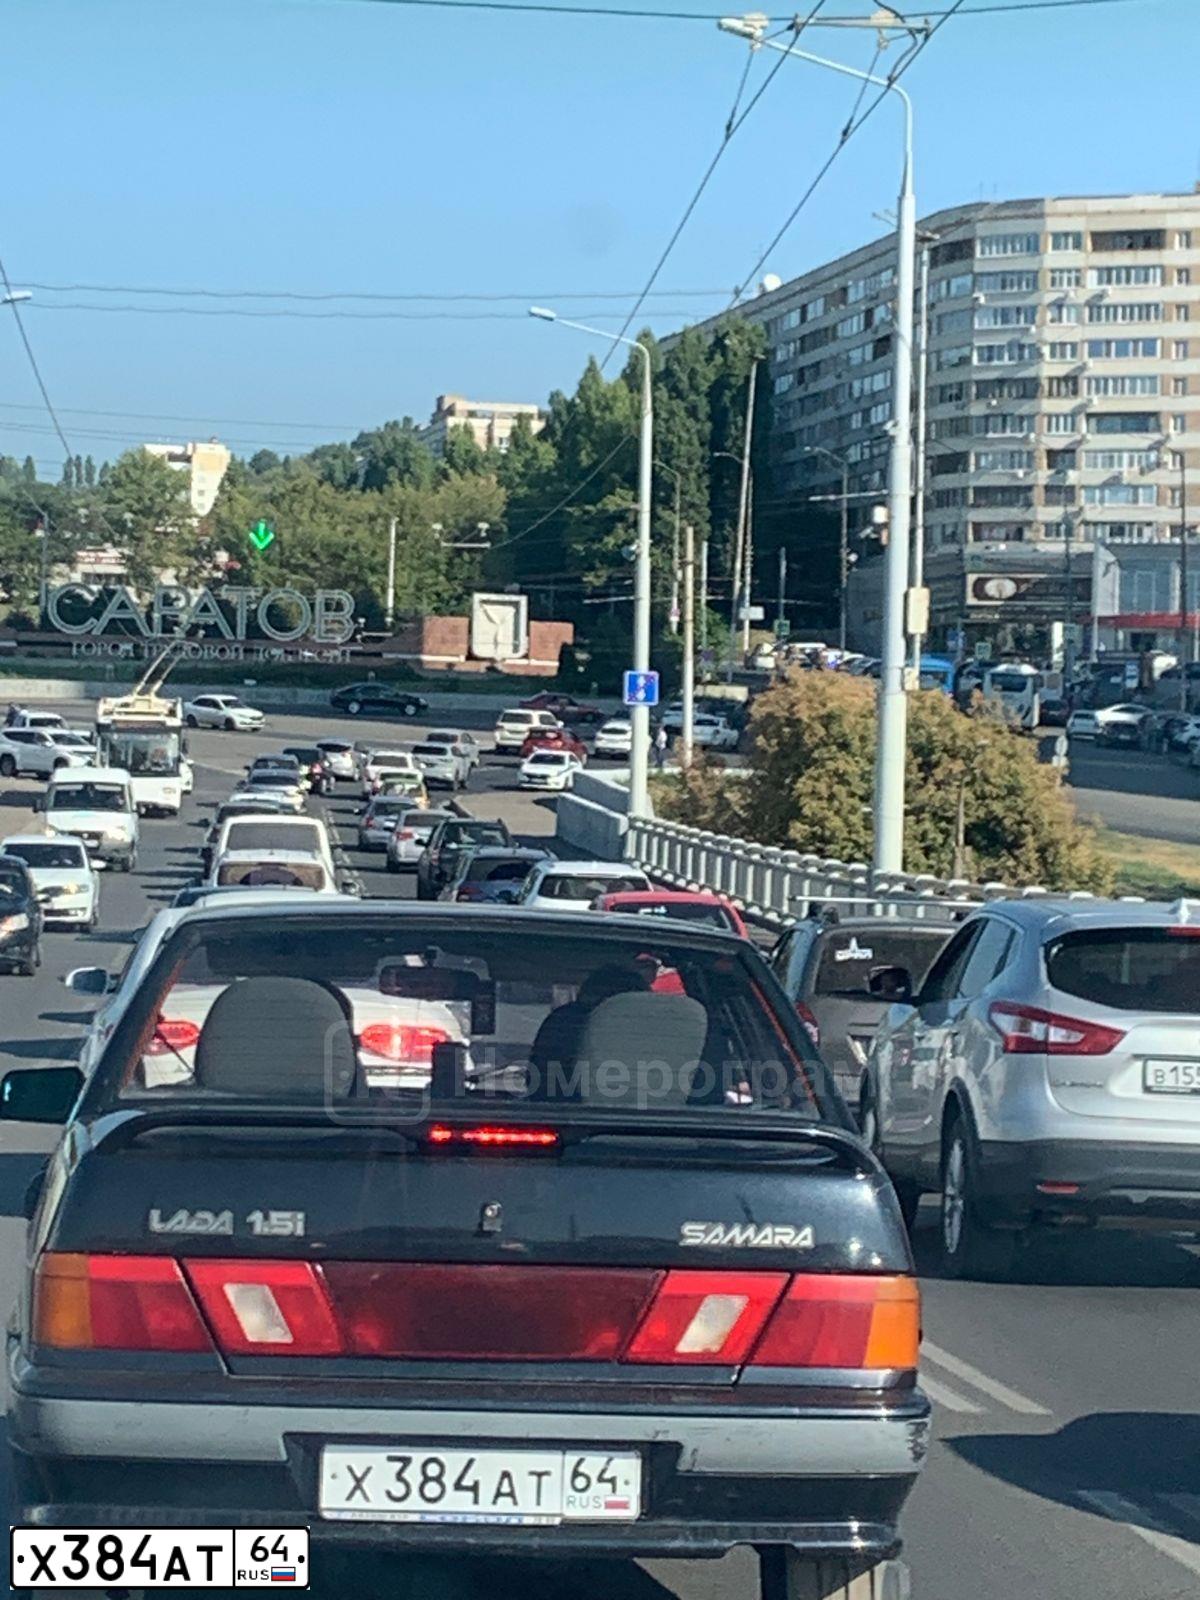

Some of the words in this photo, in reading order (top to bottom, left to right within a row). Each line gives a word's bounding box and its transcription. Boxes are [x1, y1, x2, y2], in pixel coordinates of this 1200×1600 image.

[49, 582, 355, 643] САРАТОВ
[150, 1209, 233, 1235] LADA
[680, 1222, 815, 1248] SAMARA
[345, 1455, 552, 1506] Х384АТ
[570, 1457, 618, 1494] 64
[565, 1494, 602, 1509] RUS
